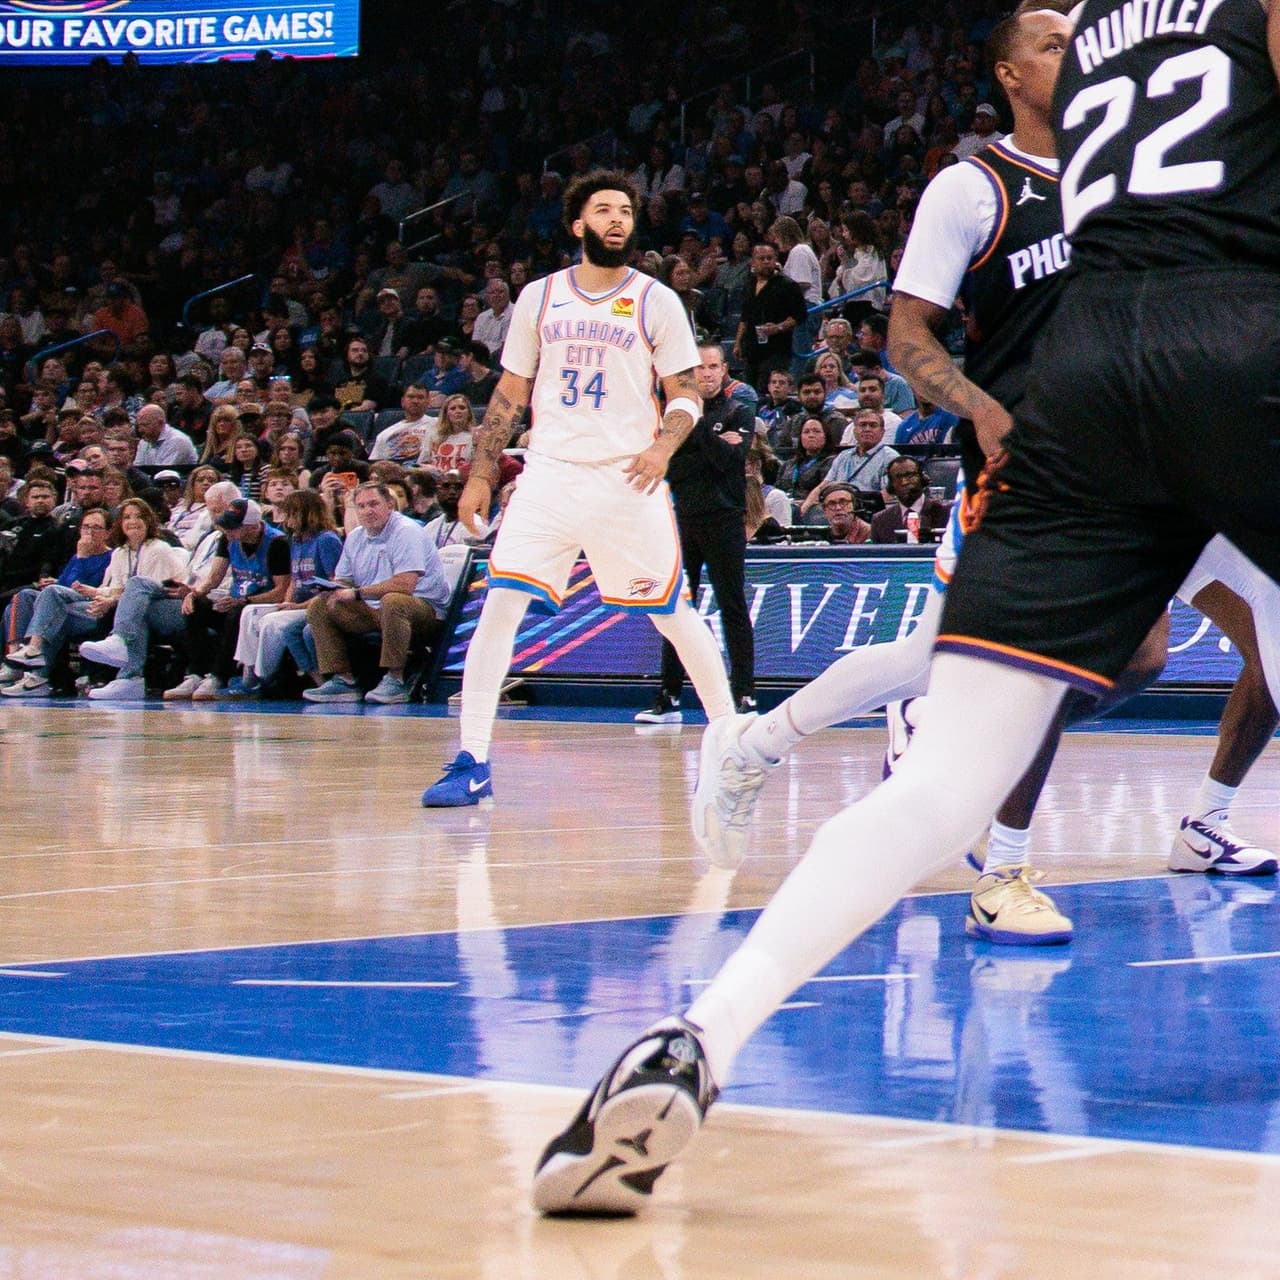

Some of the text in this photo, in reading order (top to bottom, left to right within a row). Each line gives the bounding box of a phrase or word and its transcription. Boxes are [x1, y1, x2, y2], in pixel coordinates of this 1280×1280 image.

[0, 12, 333, 46] UR FAVORITE GAMES!
[1061, 45, 1231, 235] 22
[542, 320, 637, 352] OKLAHOMA
[565, 343, 607, 366] CITY
[559, 368, 608, 410] 34
